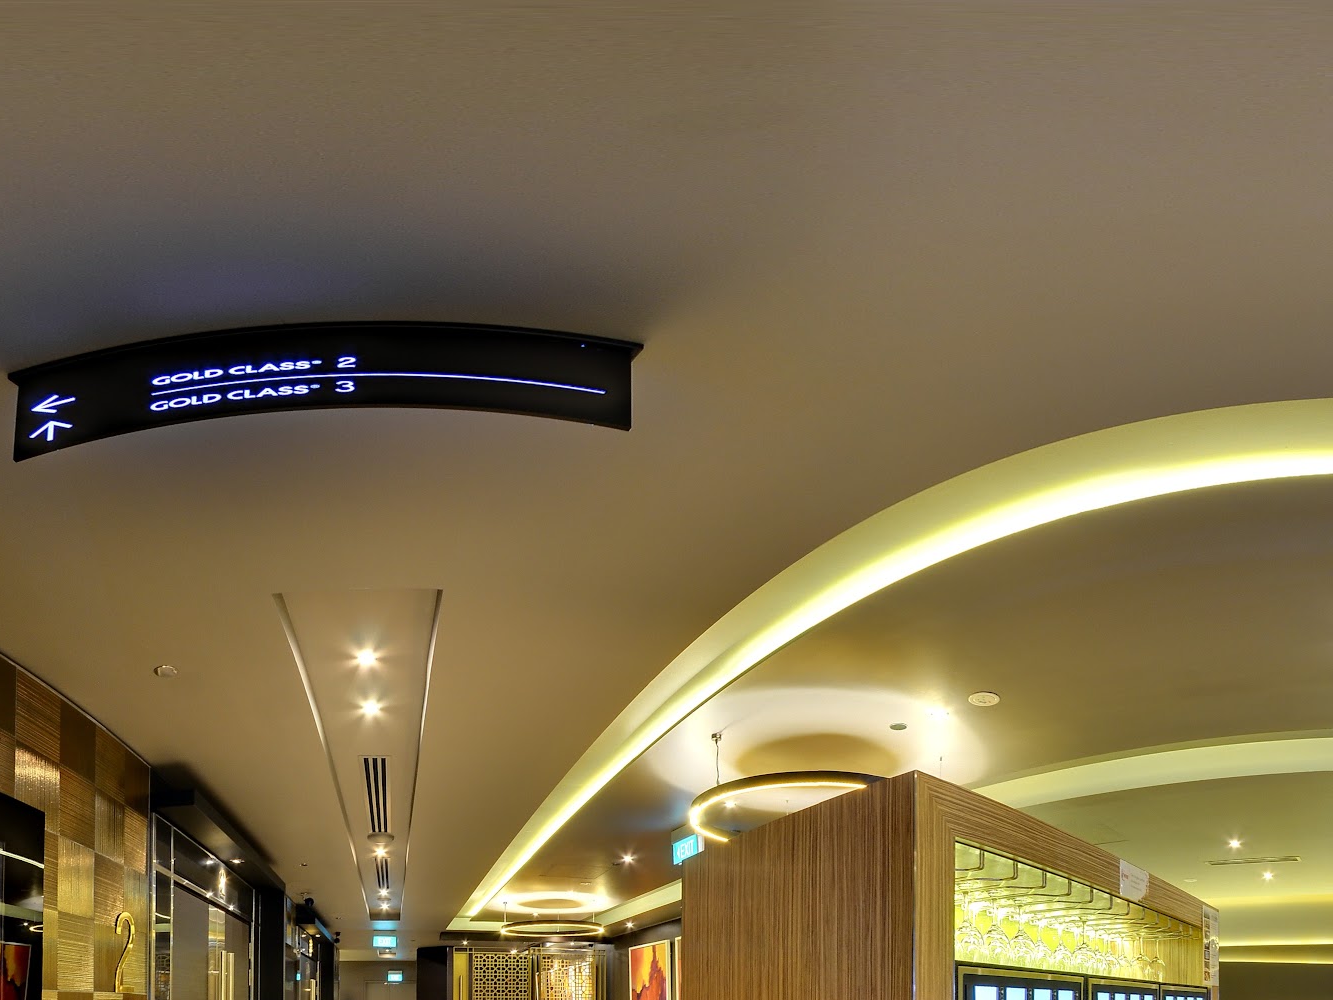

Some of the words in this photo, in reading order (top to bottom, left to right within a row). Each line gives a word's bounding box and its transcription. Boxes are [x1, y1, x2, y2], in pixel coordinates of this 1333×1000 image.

[152, 368, 224, 386] GOLD
[337, 356, 356, 368] 2
[150, 393, 222, 411] GOLD
[335, 380, 355, 393] 3
[680, 840, 694, 858] EXIT
[115, 911, 135, 993] 2
